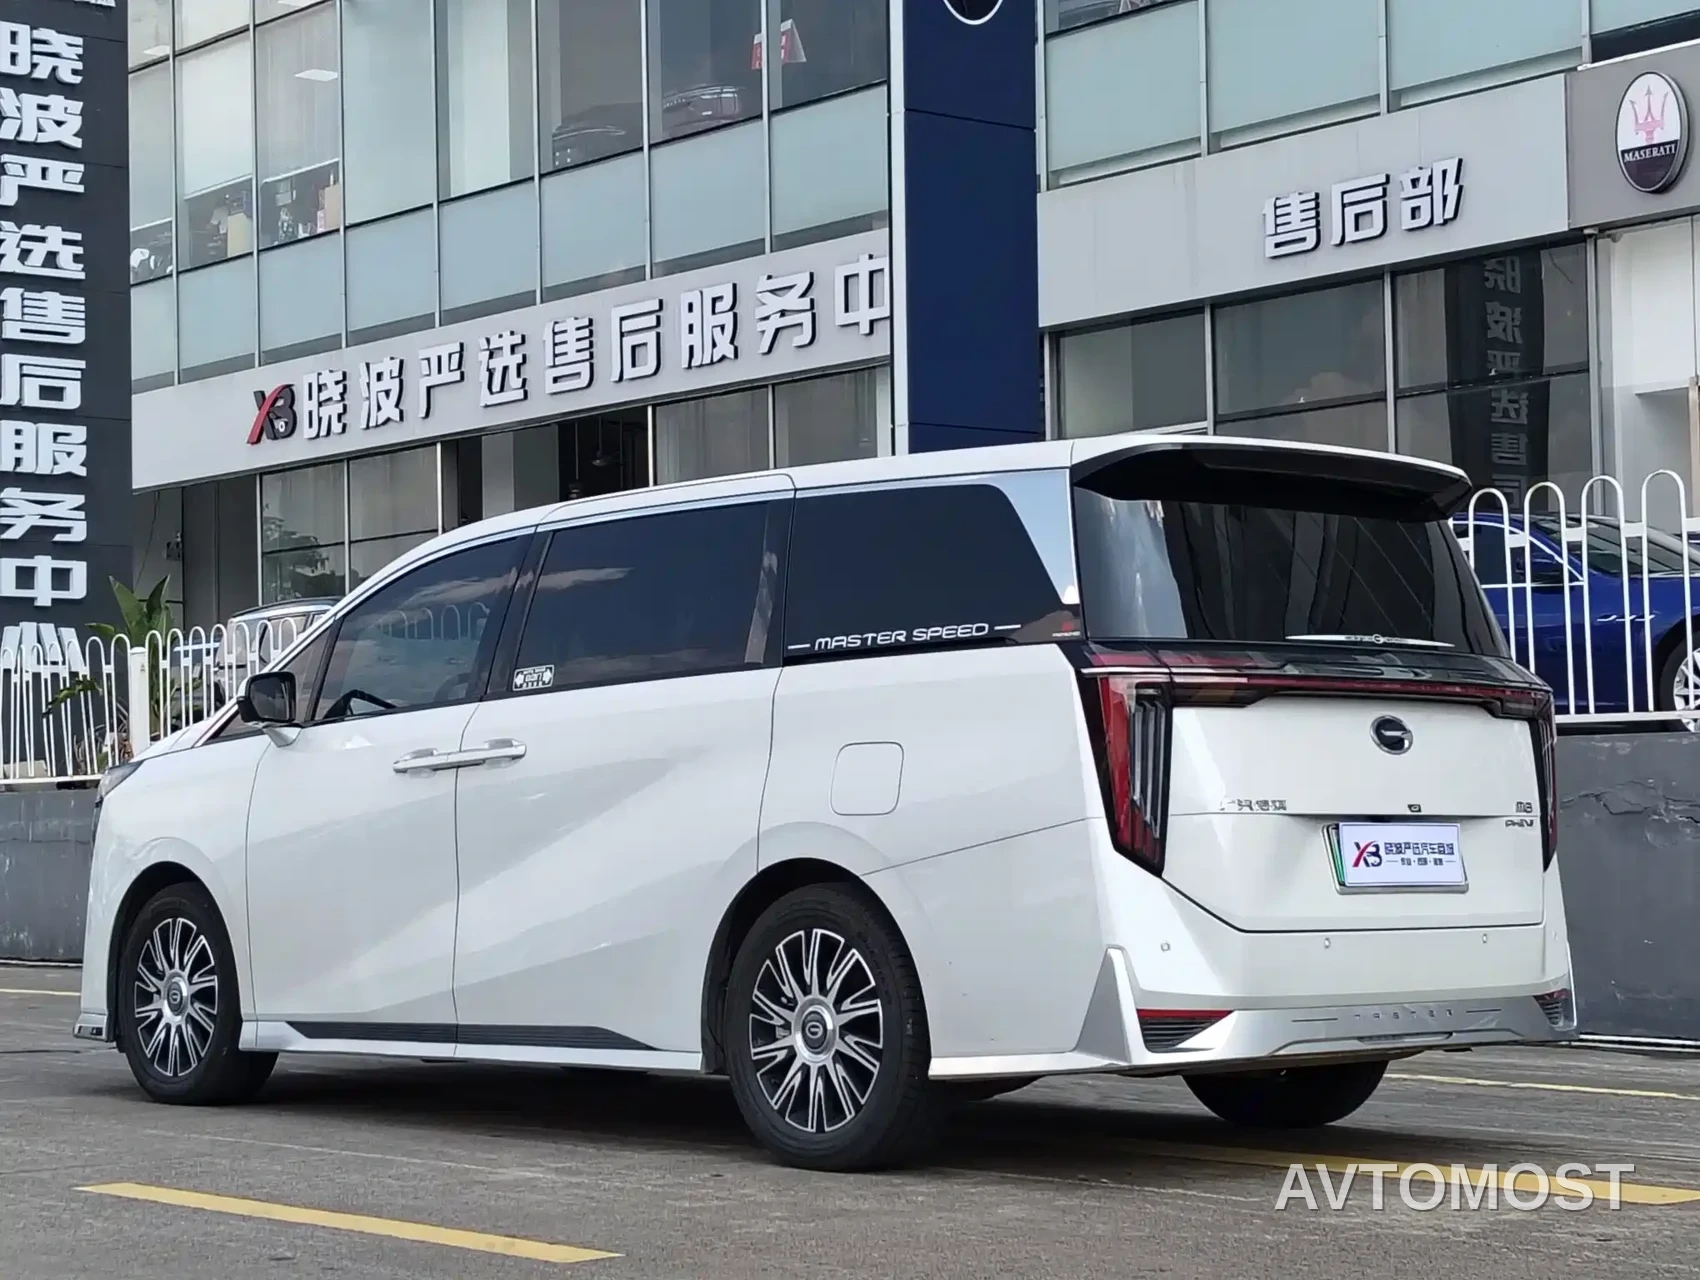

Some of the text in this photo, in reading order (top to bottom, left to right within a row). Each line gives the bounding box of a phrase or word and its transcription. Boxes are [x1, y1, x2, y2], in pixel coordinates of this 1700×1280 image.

[1624, 143, 1677, 163] MASERATI
[1262, 156, 1464, 259] 售后部
[302, 252, 890, 440] 晓波严选售后服务中
[814, 622, 989, 651] MASTER SPEED
